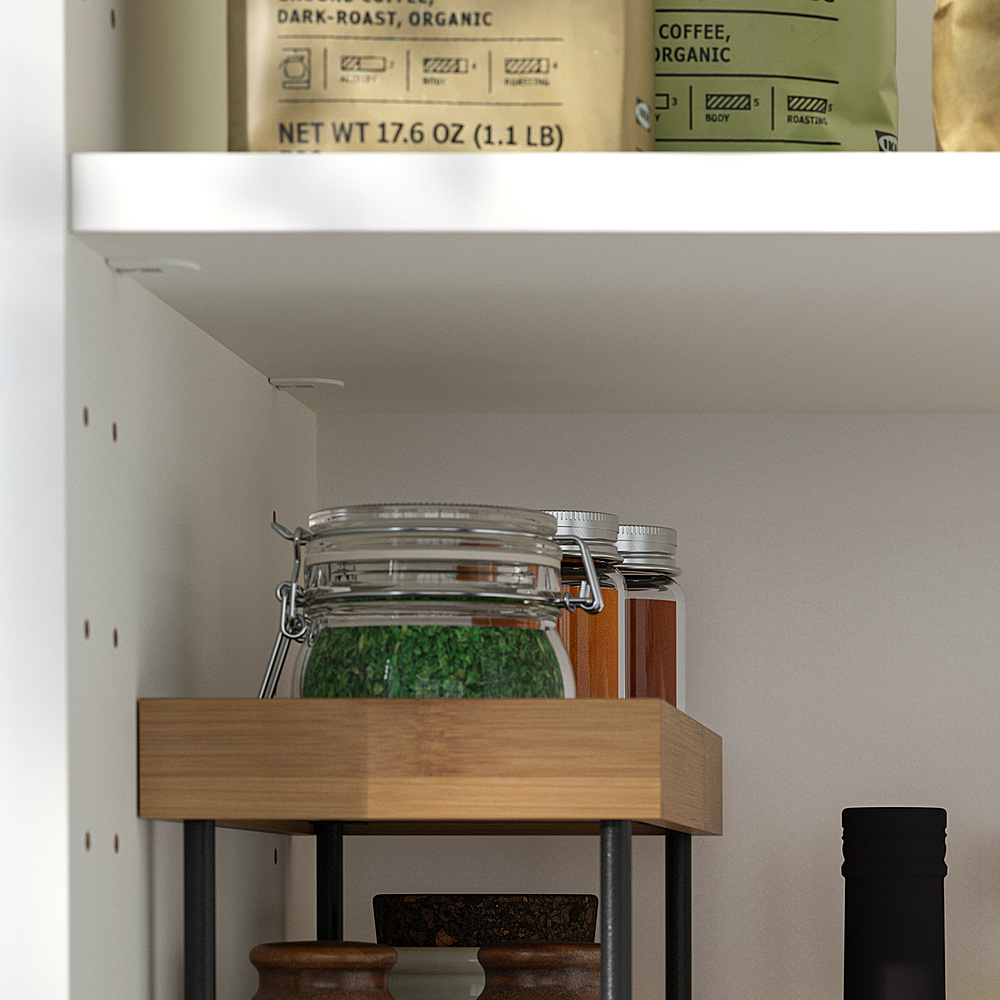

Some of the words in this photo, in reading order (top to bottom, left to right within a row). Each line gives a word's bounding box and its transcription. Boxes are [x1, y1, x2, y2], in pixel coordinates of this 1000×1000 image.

[278, 9, 402, 29] DARK-ROAST,
[409, 11, 492, 27] ORGANIC
[659, 23, 731, 43] COFFEE,
[671, 97, 678, 106] 3
[753, 98, 760, 107] 5
[828, 103, 834, 112] 5
[705, 113, 730, 123] BODY
[787, 114, 828, 126] ROASTING
[279, 122, 324, 144] NET
[332, 122, 370, 144] WT
[378, 122, 425, 144] 17.6
[433, 123, 465, 144] OZ
[474, 123, 517, 150] (1.1
[527, 124, 563, 152] LB)
